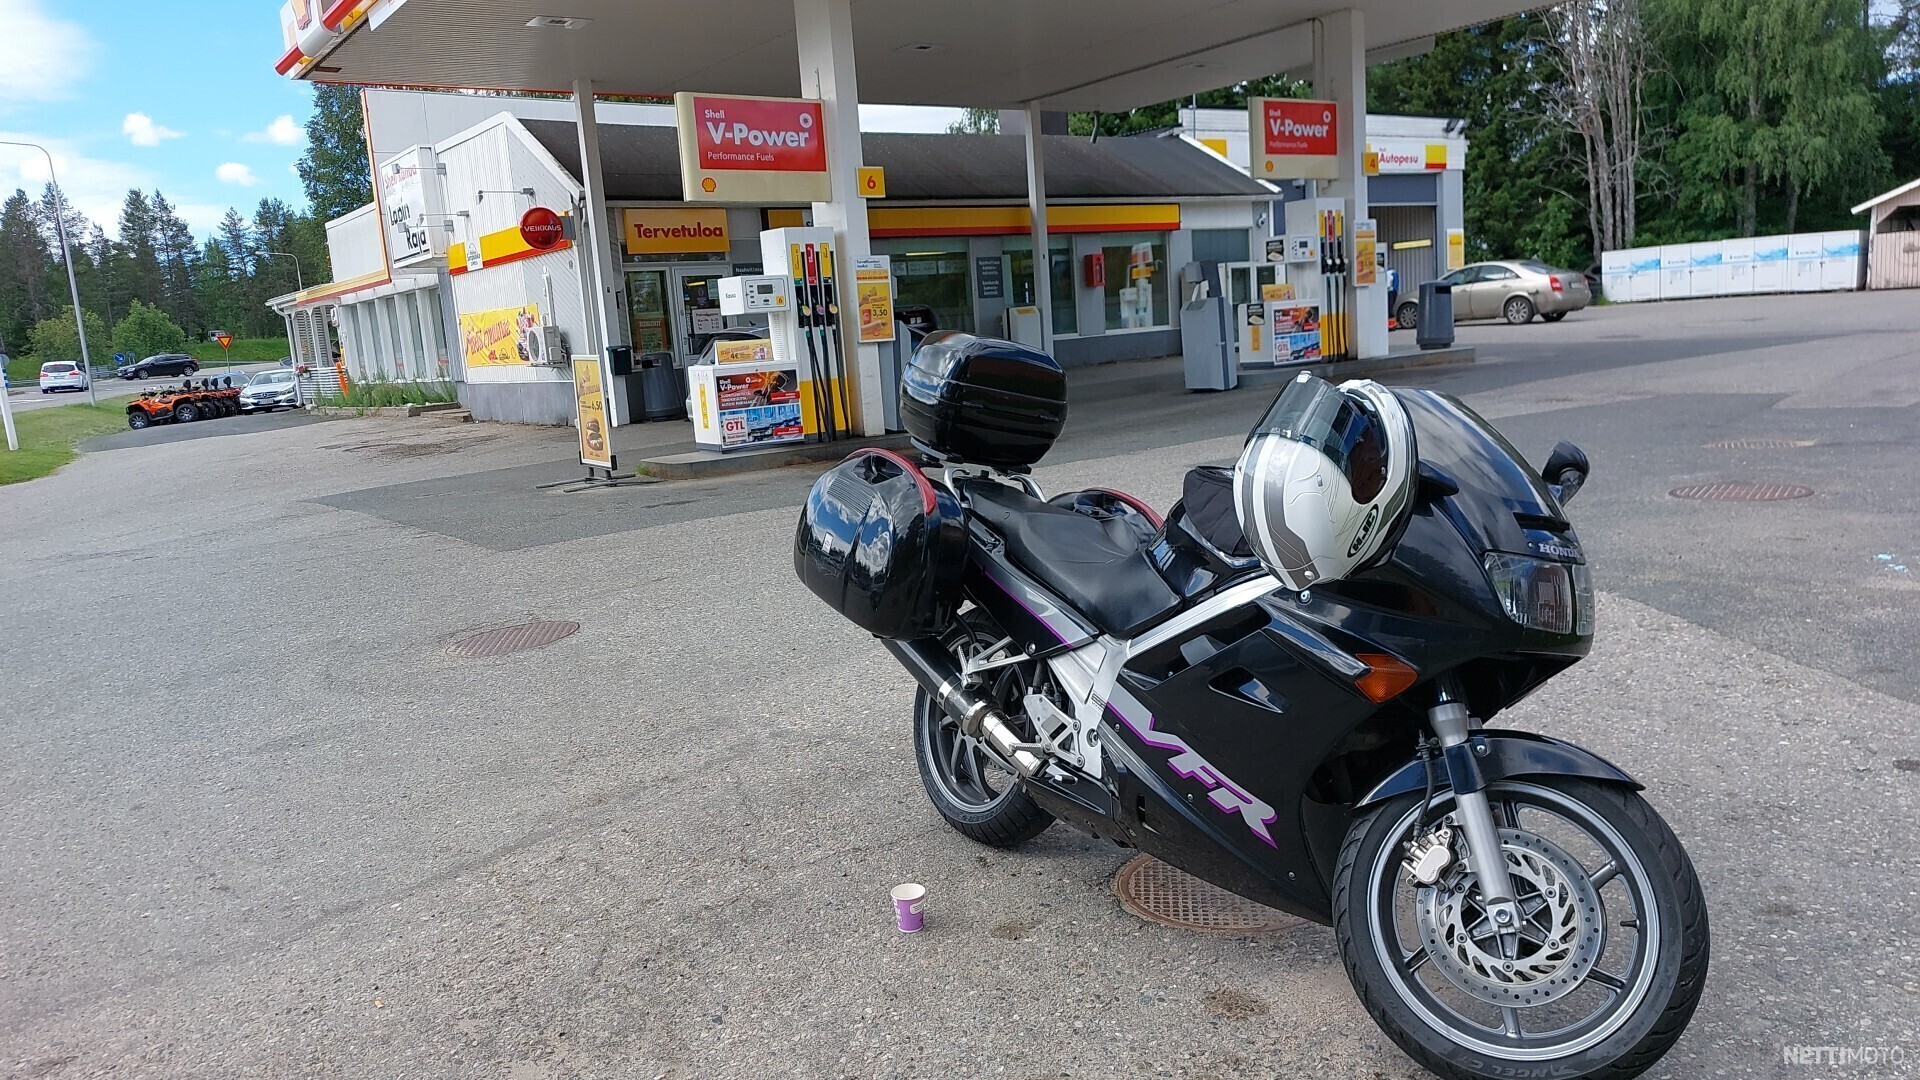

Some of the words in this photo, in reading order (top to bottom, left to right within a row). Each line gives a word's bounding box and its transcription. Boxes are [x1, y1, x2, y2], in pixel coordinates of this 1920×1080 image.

[704, 108, 725, 119] Shell
[706, 121, 809, 147] V-Power
[1269, 118, 1329, 138] V-Power
[707, 151, 755, 161] Performance
[756, 152, 775, 162] Fuels
[1369, 158, 1376, 169] 4
[1379, 152, 1419, 166] Autopesu
[866, 175, 877, 190] 6
[523, 224, 562, 232] VEIKKAUS
[634, 221, 724, 239] Tervetuloa
[405, 222, 427, 254] Raja
[872, 308, 888, 318] 3,50
[730, 352, 740, 360] 4€
[720, 383, 750, 391] V-Power
[726, 420, 745, 431] GTL
[1351, 510, 1377, 552] HJC
[1538, 543, 1580, 558] HONDA
[1107, 682, 1278, 849] VFR
